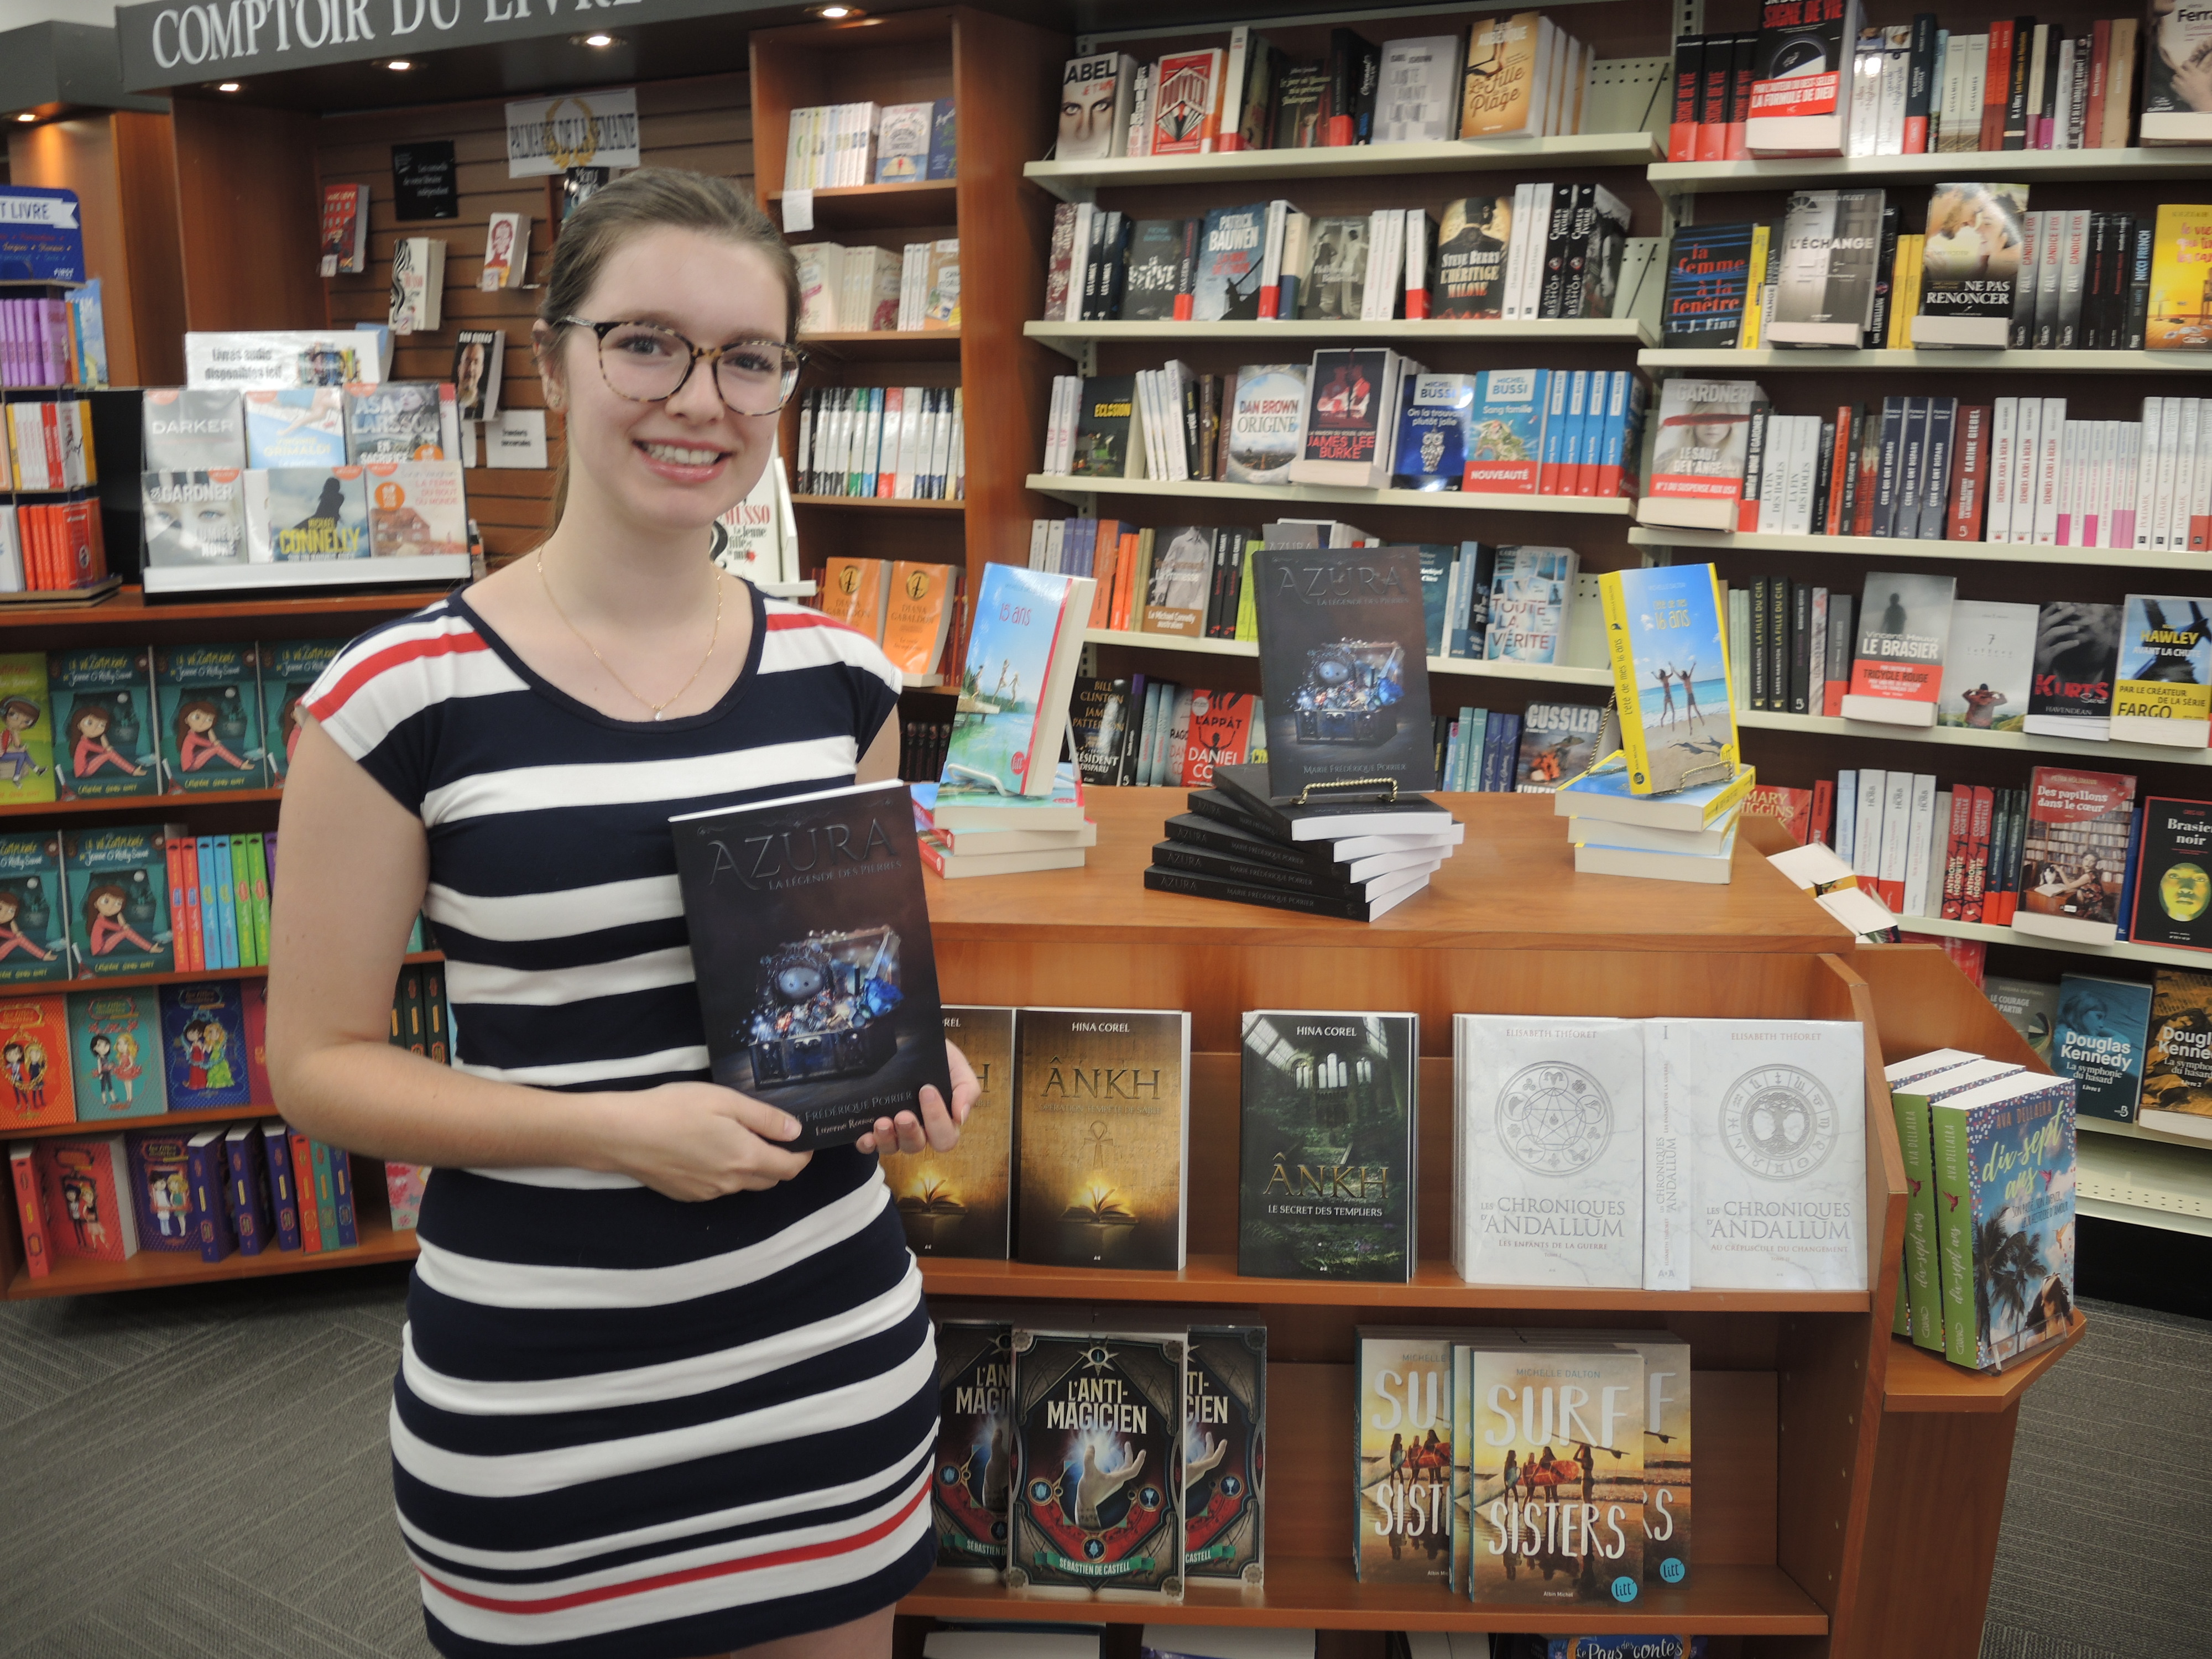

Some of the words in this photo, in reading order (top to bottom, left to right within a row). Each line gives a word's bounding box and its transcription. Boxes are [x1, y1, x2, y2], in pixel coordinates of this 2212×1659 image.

[152, 0, 374, 69] COMPTOIR
[392, 0, 461, 34] DU
[1063, 59, 1118, 84] ABEL
[1485, 70, 1526, 94] Fille
[1471, 90, 1521, 117] Plage
[1752, 95, 1764, 108] LA
[1766, 89, 1801, 106] FORMULE
[1803, 88, 1813, 102] DE
[1815, 85, 1834, 100] DIEU
[11, 202, 50, 220] LIVRE
[1219, 212, 1254, 229] PATRICK
[1209, 229, 1259, 251] BAUWEN
[1790, 237, 1875, 249] L'ÉCHANGE
[2137, 230, 2151, 258] FRENCH
[1692, 243, 1708, 259] la
[1678, 258, 1745, 274] femme
[2136, 258, 2148, 280] NICCI
[1696, 280, 1707, 296] à
[1716, 279, 1731, 294] la
[1965, 281, 1984, 291] NE
[1986, 280, 2010, 291] PAS
[1673, 294, 1740, 314] fenêtre
[1926, 293, 2009, 304] RENONCER
[212, 347, 241, 362] Livres
[244, 349, 272, 361] audio
[205, 365, 264, 380] disponibles
[1421, 388, 1456, 398] BUSSI
[1493, 384, 1528, 394] BUSSI
[1677, 385, 1748, 403] GARDNER
[1239, 400, 1259, 414] DAN
[1262, 400, 1298, 414] BROWN
[1483, 406, 1504, 415] Sang
[1505, 405, 1532, 414] famille
[152, 420, 233, 434] DARKER
[1238, 416, 1297, 433] ORIGINE
[1968, 409, 1981, 438] GIEBEL
[1307, 436, 1347, 448] JAMES
[1353, 436, 1375, 448] LEE
[1319, 447, 1360, 459] BURKE
[1964, 441, 1977, 472] KARINE
[1471, 469, 1529, 481] NOUVEAUTÉ
[160, 484, 232, 502] GARDNER
[725, 505, 770, 525] MUSSO
[280, 527, 361, 554] CONNELLY
[1277, 566, 1406, 604] AZURA
[999, 603, 1010, 620] 15
[1013, 607, 1031, 625] ans
[1491, 597, 1546, 615] TOUTE
[1655, 611, 1667, 629] 16
[1670, 609, 1690, 628] ans
[1493, 630, 1549, 649] VÉRITÉ
[1988, 634, 1995, 644] 7
[2140, 630, 2199, 644] HAWLEY
[1862, 639, 1879, 654] LE
[1881, 641, 1938, 659] BRASIER
[2173, 648, 2201, 657] CHUTE
[1864, 669, 1900, 681] TRICYCLE
[1902, 671, 1928, 682] ROUGE
[1094, 681, 1112, 691] BILL
[2034, 675, 2109, 699] KURTS
[2119, 686, 2134, 694] PAR
[2136, 686, 2146, 695] LE
[2148, 686, 2187, 696] CRÉATEUR
[1080, 692, 1123, 703] CLINTON
[2183, 697, 2205, 707] SÉRIE
[2118, 702, 2172, 718] FARGO
[1196, 715, 1242, 729] L'APPÂT
[1526, 705, 1600, 733] CUSSLER
[1304, 765, 1328, 774] MARIE
[1329, 764, 1375, 774] FRÉDÉRIQUE
[1377, 763, 1406, 771] POIRIER
[1746, 792, 1788, 805] MARY
[2037, 786, 2056, 797] Des
[2058, 790, 2108, 802] papillons
[2037, 797, 2062, 808] dans
[2065, 800, 2075, 809] le
[2077, 802, 2104, 812] cœur
[2176, 834, 2206, 845] noir
[706, 817, 899, 890] AZURA
[1167, 853, 1201, 867] AZURA
[769, 880, 783, 890] LA
[785, 872, 834, 888] LÉGENDE
[838, 867, 859, 878] DES
[861, 860, 902, 875] PIERRES
[1999, 997, 2029, 1007] COURAGE
[1999, 1005, 2022, 1014] PARTIR
[1072, 1021, 1095, 1031] HINA
[1098, 1022, 1130, 1033] COREL
[1297, 1026, 1322, 1036] HINA
[1324, 1027, 1357, 1036] COREL
[1506, 1029, 1551, 1038] ELISABETH
[1555, 1029, 1597, 1039] THÉORET
[1731, 1032, 1776, 1041] ELISABETH
[1781, 1032, 1820, 1041] THÉORET
[2065, 1031, 2131, 1053] Douglas
[2060, 1045, 2132, 1071] Kennedy
[1041, 1055, 1160, 1100] ÂNKH
[2067, 1062, 2076, 1071] La
[2078, 1064, 2122, 1079] symphonie
[2086, 1072, 2113, 1084] hasard
[806, 1100, 870, 1123] FRÉDÉRIQUE
[872, 1091, 912, 1108] POIRIER
[1996, 1113, 2012, 1129] AVA
[2016, 1100, 2052, 1124] DELLAIRA
[816, 1123, 847, 1136] Luzerne
[1982, 1099, 2065, 1182] dix-sept
[1263, 1151, 1389, 1199] ÂNKH
[1656, 1137, 1665, 1205] CHRONIQUES
[2005, 1166, 2038, 1201] ans
[1269, 1204, 1277, 1214] LE
[1280, 1205, 1312, 1214] SECRET
[1315, 1207, 1332, 1215] DES
[1334, 1207, 1383, 1217] TEMPLIERS
[1498, 1197, 1625, 1217] CHRONIQUES
[1724, 1202, 1850, 1220] CHRONIQUES
[1481, 1214, 1624, 1238] D'ANDALLUM
[1707, 1218, 1850, 1240] D'ANDALLUM
[1725, 1243, 1774, 1252] CRÉPUSCULE
[1402, 1354, 1446, 1363] MICHELLE
[1517, 1368, 1562, 1378] MICHELLE
[1566, 1369, 1600, 1379] DALTON
[1068, 1378, 1127, 1402] L'ANTI-
[1047, 1401, 1147, 1434] MAGICIEN
[1485, 1384, 1630, 1447] SURF
[1489, 1502, 1626, 1559] SISTERS
[967, 1538, 999, 1555] SÉBASTIEN
[1186, 1550, 1211, 1564] CASTELL
[1060, 1557, 1093, 1574] SÉBASTIEN
[1095, 1565, 1102, 1574] DE
[1103, 1562, 1130, 1575] CASTELL
[1577, 1648, 1586, 1658] Le
[1588, 1643, 1623, 1659] Pays
[1621, 1640, 1634, 1651] des
[1634, 1638, 1682, 1659] contes
